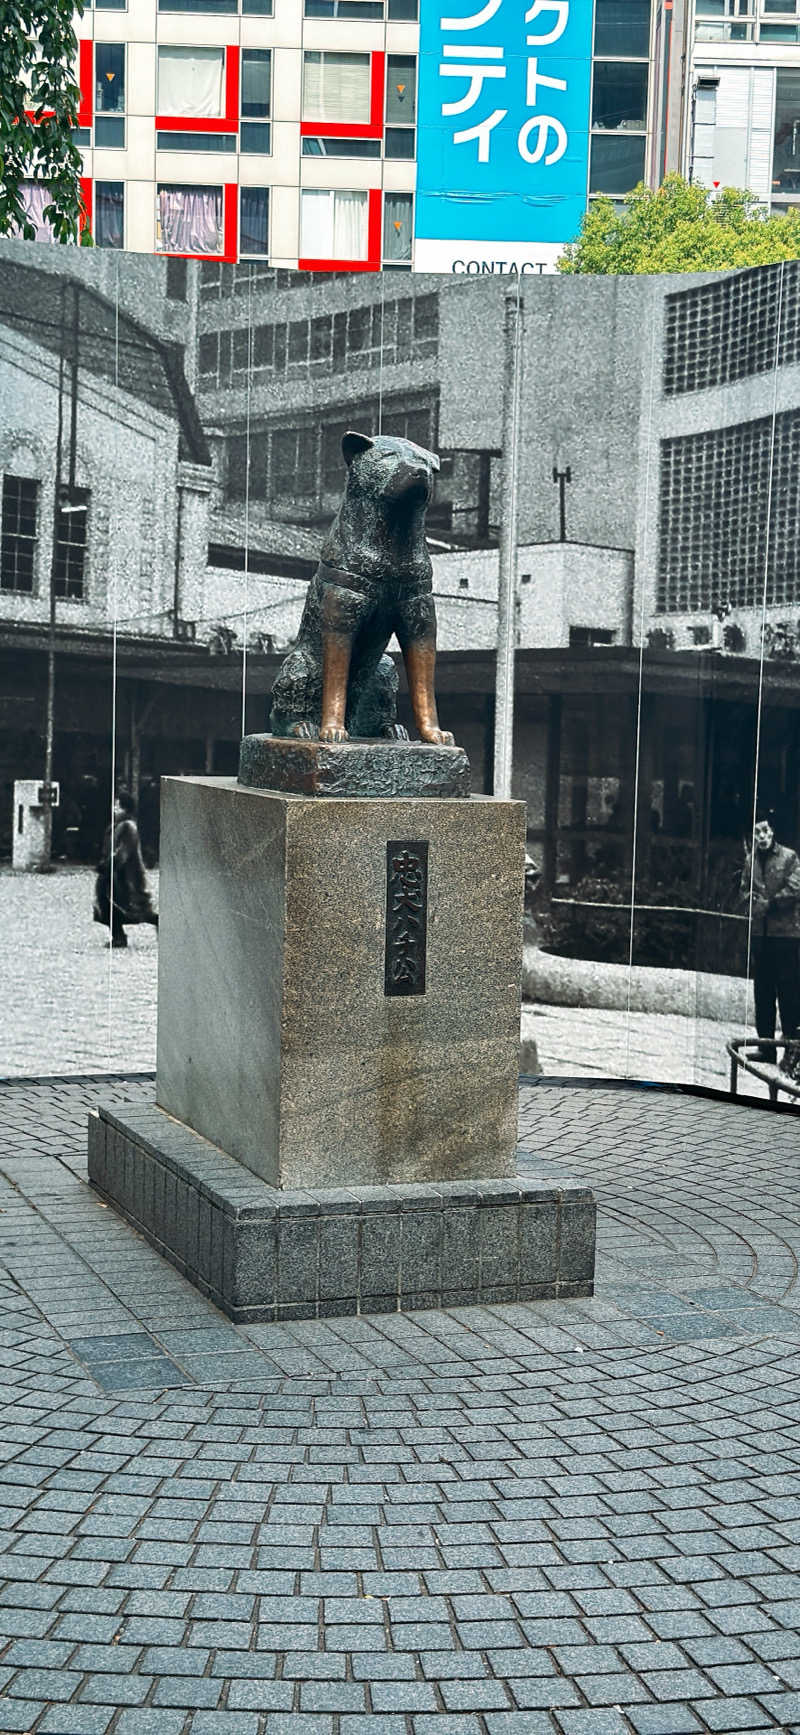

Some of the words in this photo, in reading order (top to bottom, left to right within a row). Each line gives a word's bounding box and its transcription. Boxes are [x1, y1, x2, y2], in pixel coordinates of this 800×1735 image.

[518, 0, 570, 166] クトの
[452, 260, 547, 274] CONTACT
[390, 849, 424, 985] 忠犬ハチ公
